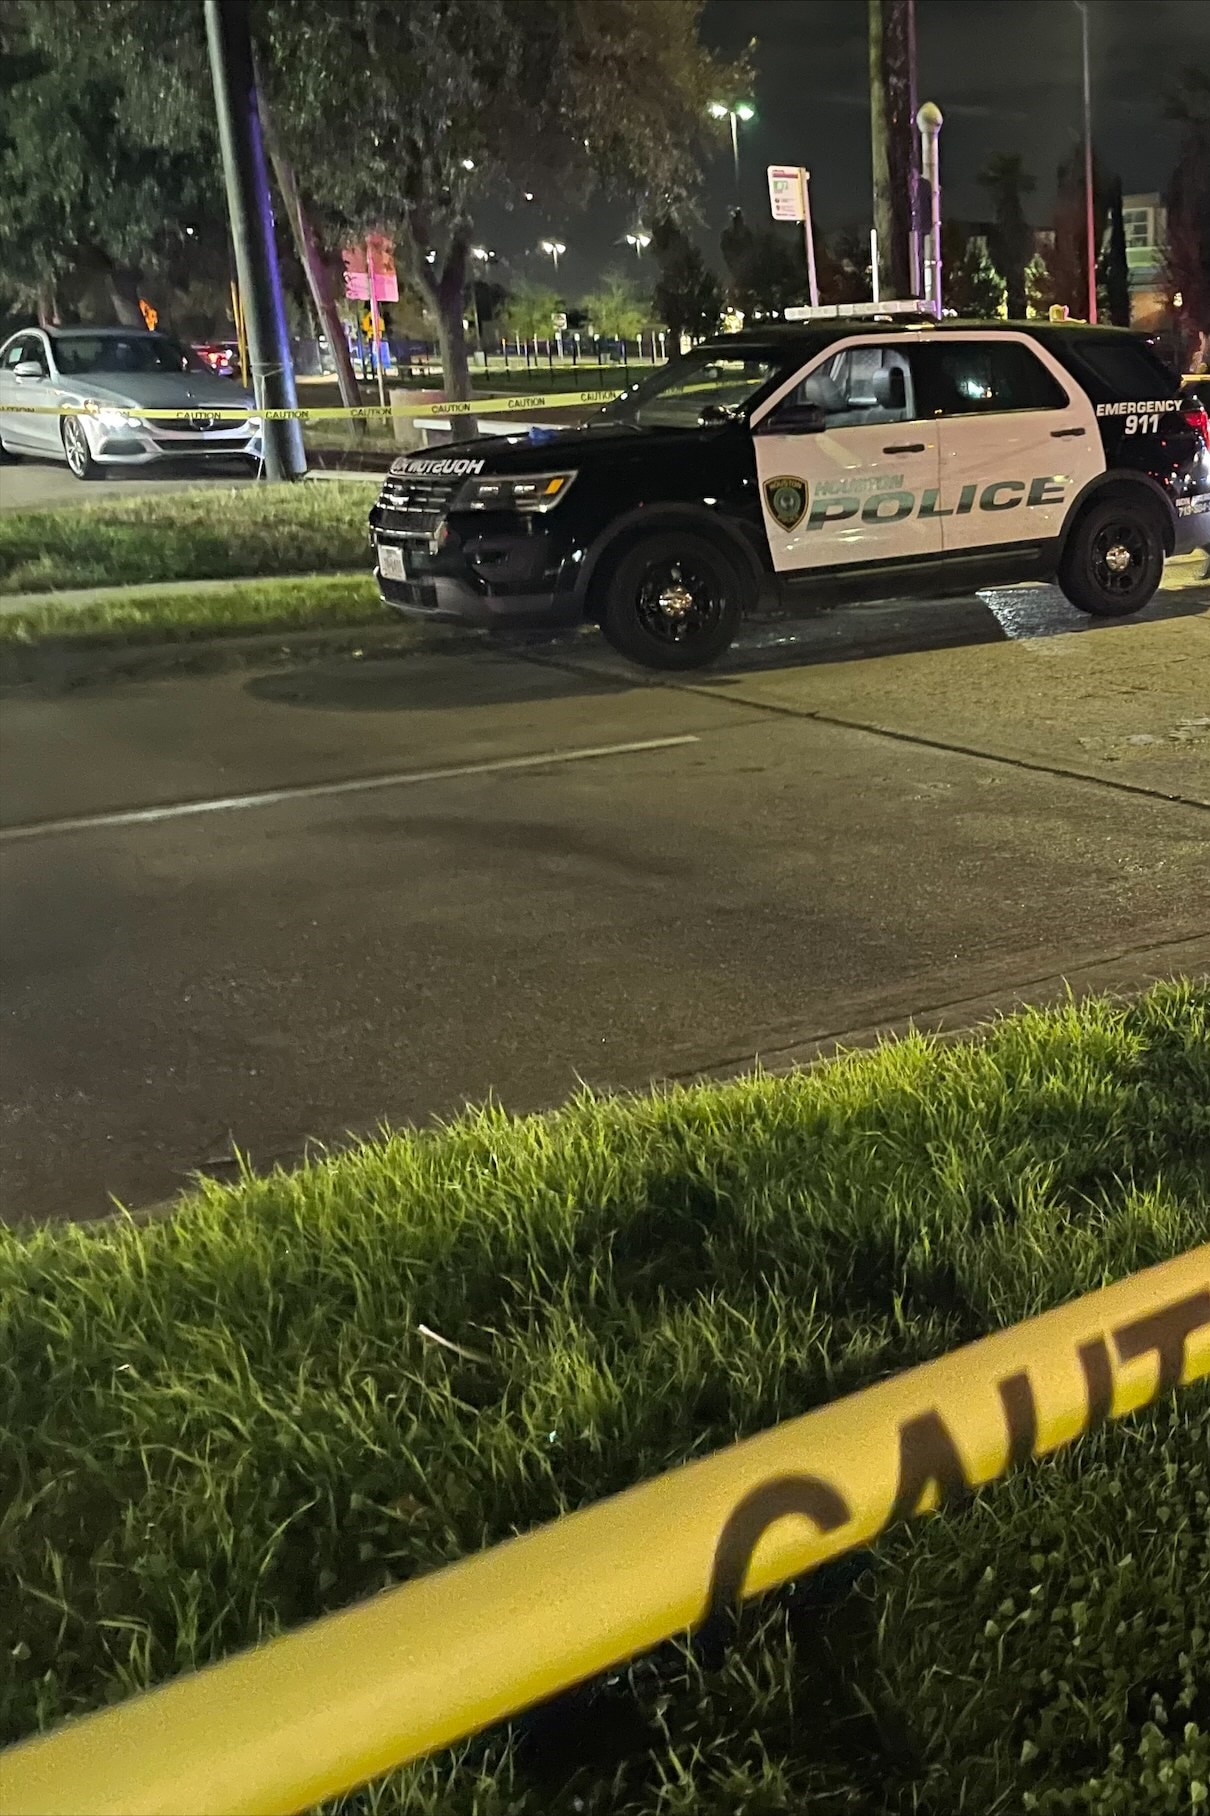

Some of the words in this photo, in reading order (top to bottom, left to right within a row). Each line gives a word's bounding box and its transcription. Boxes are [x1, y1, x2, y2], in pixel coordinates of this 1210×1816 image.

[580, 390, 617, 402] CAUTION
[431, 404, 471, 413] CAUTION
[507, 398, 545, 409] CAUTION
[1096, 400, 1182, 417] EMERGENCY
[176, 411, 222, 420] CAUTION
[265, 410, 309, 419] CAUTION
[350, 407, 392, 417] CAUTION
[1124, 414, 1160, 435] 911
[806, 475, 1069, 531] POLICE
